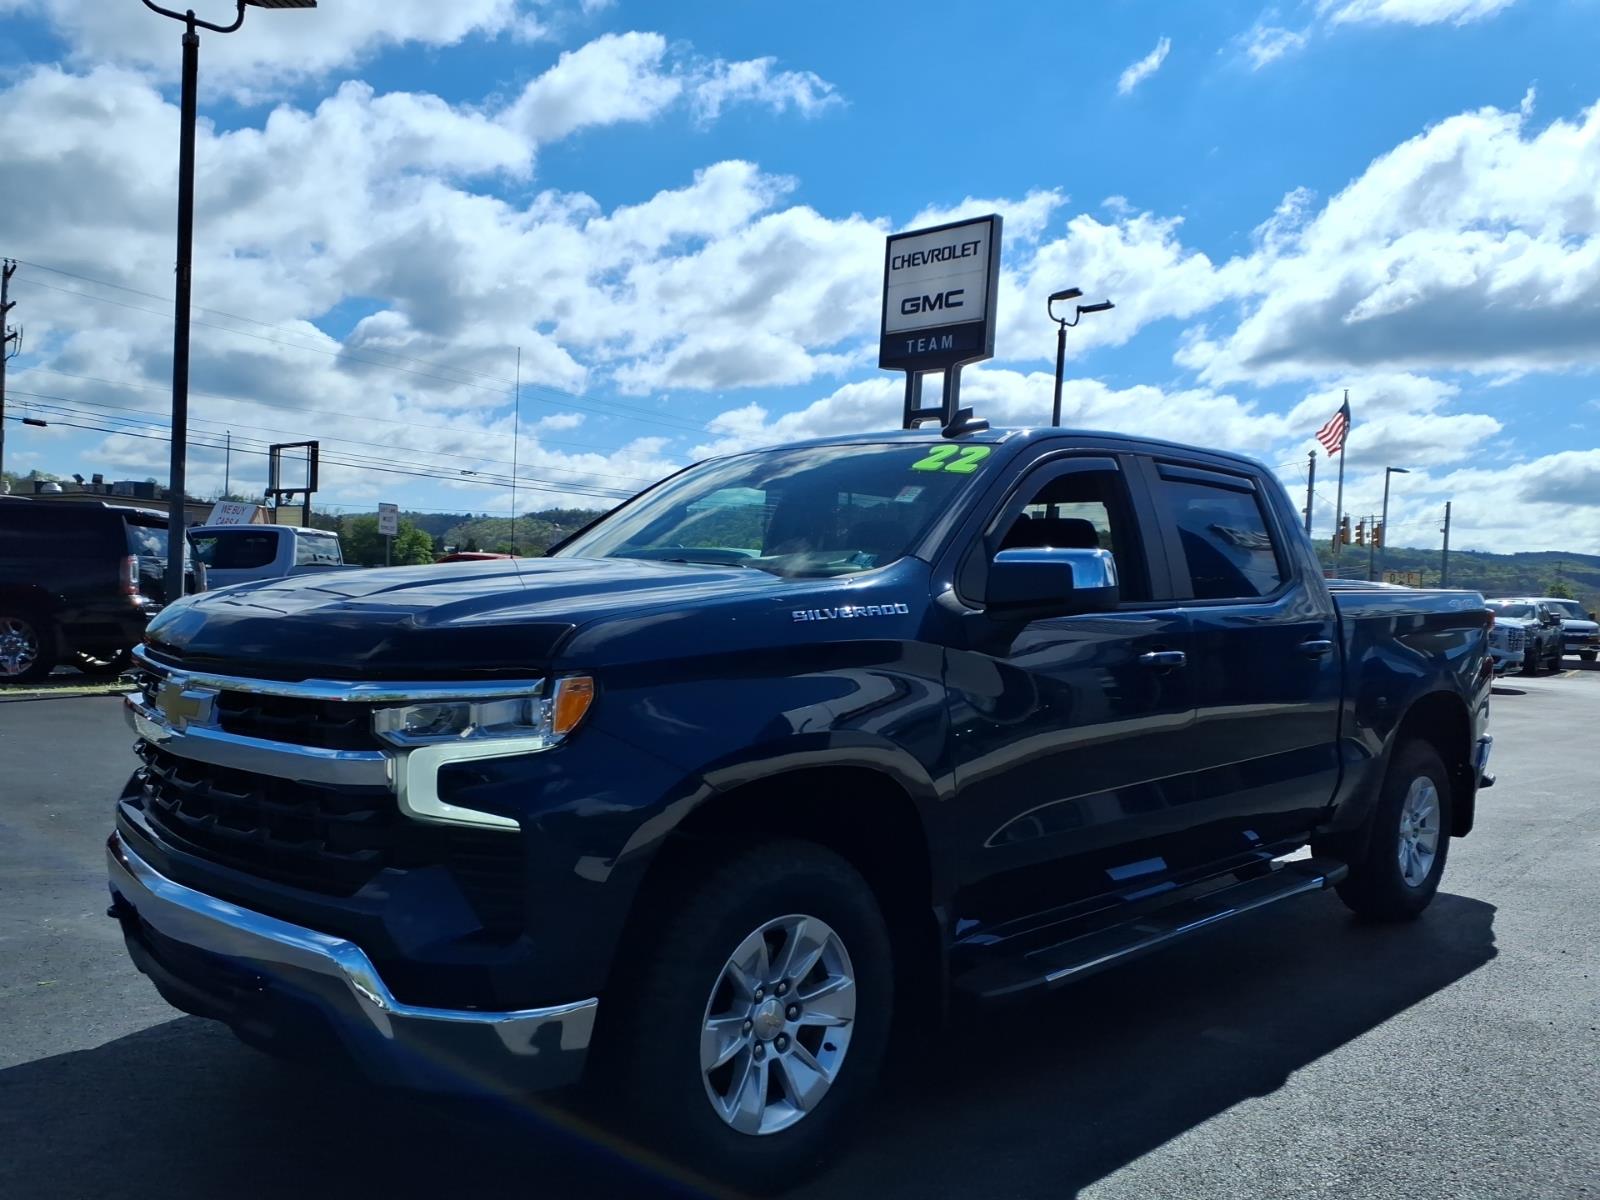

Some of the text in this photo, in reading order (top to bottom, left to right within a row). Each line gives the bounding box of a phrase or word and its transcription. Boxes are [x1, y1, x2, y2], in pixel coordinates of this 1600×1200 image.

[892, 240, 981, 270] CHEVROLET
[901, 289, 964, 315] GMC
[906, 334, 953, 352] TEAM
[911, 444, 991, 473] 22
[232, 505, 247, 515] BUY
[791, 603, 909, 622] SILVERADO
